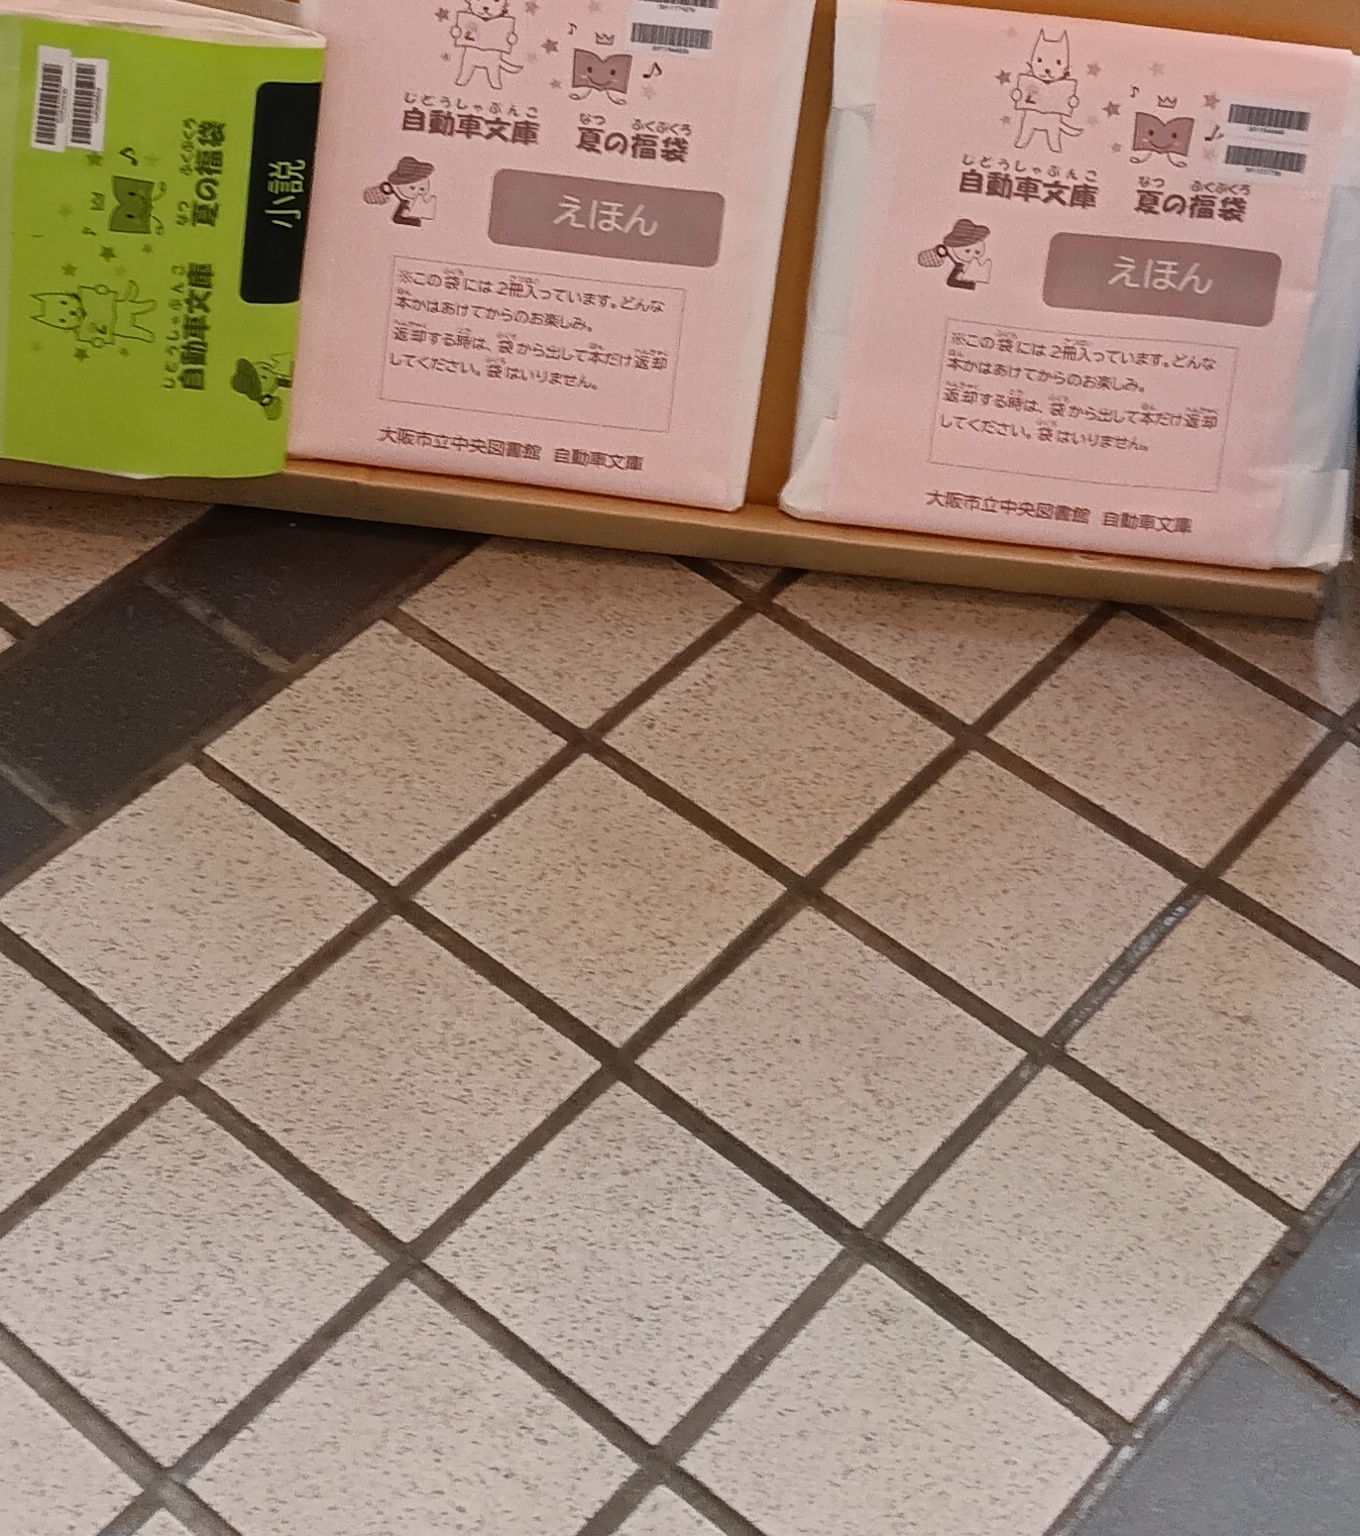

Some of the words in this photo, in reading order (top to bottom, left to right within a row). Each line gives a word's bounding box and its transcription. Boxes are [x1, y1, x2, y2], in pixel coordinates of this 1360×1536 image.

[401, 107, 539, 146] 自動車文庫
[576, 126, 689, 163] 夏の福袋
[264, 159, 306, 228] 小説
[552, 195, 658, 237] えほん
[958, 169, 1099, 210] 自動車文庫
[1134, 188, 1247, 223] 夏の福袋
[1107, 255, 1213, 296] えほん
[378, 425, 542, 461] 大阪市立中央図書館
[554, 447, 644, 472] 自動車文庫
[926, 490, 1090, 525] 大阪市立中央図書館
[1102, 511, 1193, 535] 自動車文庫
